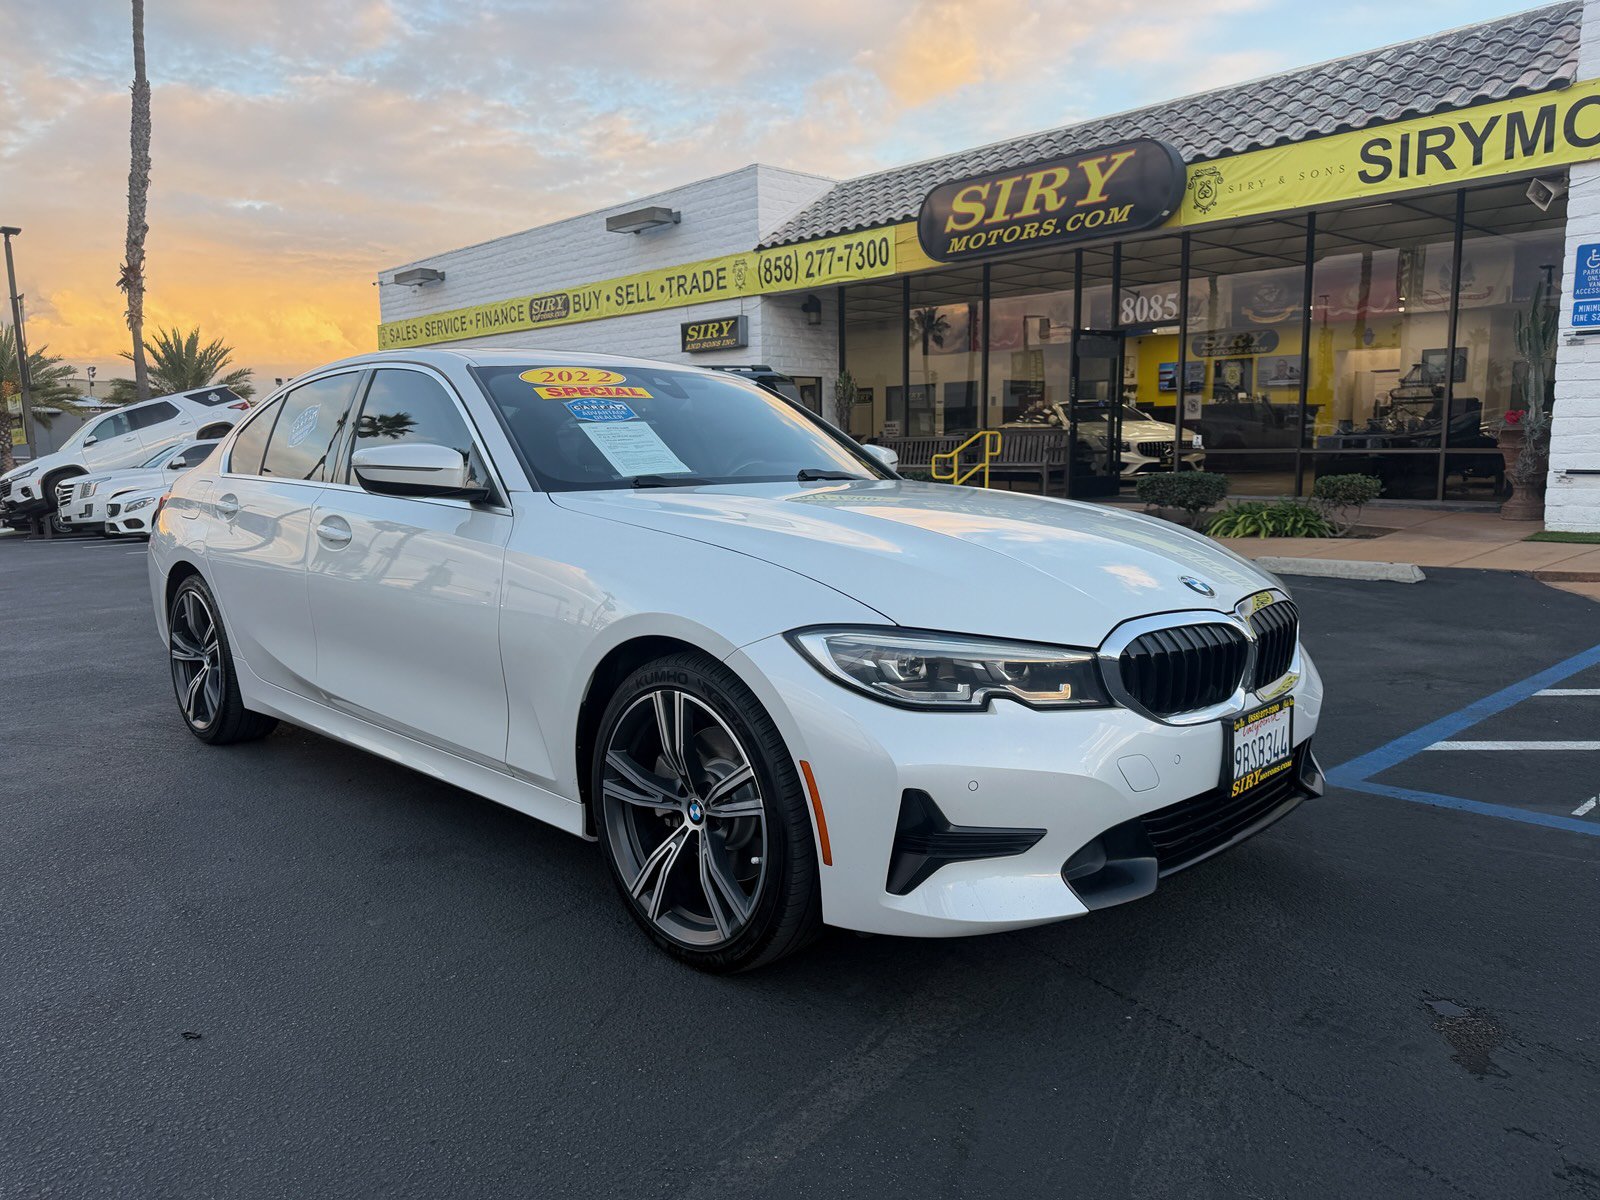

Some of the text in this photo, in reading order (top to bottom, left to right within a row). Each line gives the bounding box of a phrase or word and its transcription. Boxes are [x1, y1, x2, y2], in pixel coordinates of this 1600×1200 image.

[944, 149, 1137, 234] SIRY
[1228, 164, 1346, 194] SIRY & SONS
[946, 203, 1135, 254] MOTORS.COM
[757, 236, 890, 289] (858) 277-7300
[531, 295, 567, 315] SIRY
[572, 267, 728, 313] BUY SELL TRADE
[389, 304, 525, 343] SALES SERVICE FINANCE
[1120, 292, 1179, 325] 8085
[1573, 314, 1588, 322] FINE
[685, 320, 736, 342] SIRY
[686, 338, 736, 351] AND SONS INC
[540, 370, 612, 383] 2022
[545, 386, 645, 398] SPECIAL
[635, 670, 688, 690] KUMHO
[1231, 768, 1262, 798] SIRY
